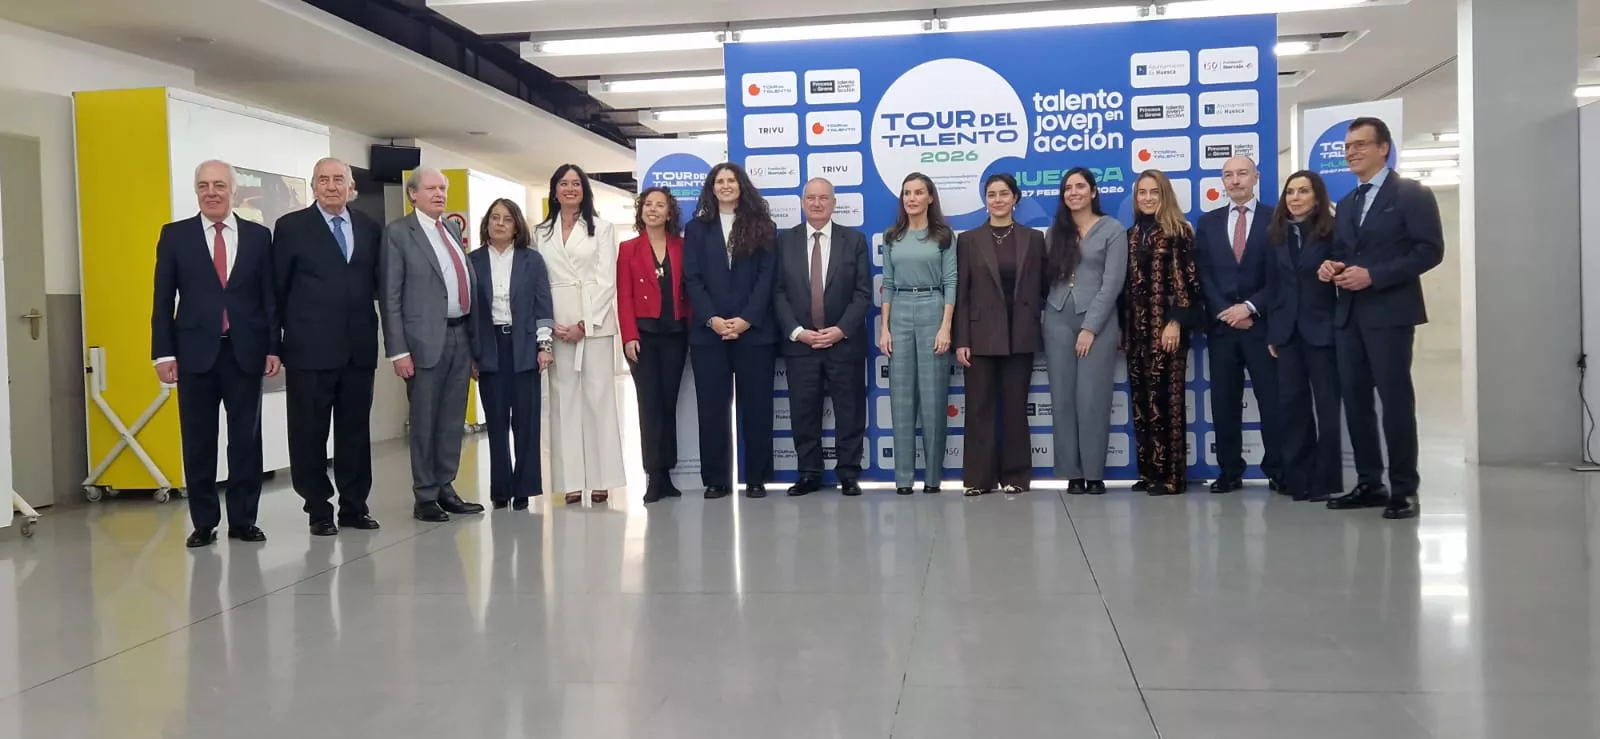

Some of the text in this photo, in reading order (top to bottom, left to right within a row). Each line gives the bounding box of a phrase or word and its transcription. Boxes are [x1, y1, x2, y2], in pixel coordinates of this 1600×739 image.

[1033, 89, 1124, 113] talento
[881, 110, 1018, 131] TOUR DEL
[1034, 110, 1124, 136] joven en
[881, 130, 1018, 148] TALENTO
[1034, 127, 1124, 153] acción
[920, 150, 979, 163] 2026
[652, 172, 692, 180] TOUR
[822, 165, 848, 173] TRIVU
[1015, 167, 1124, 186] UECA
